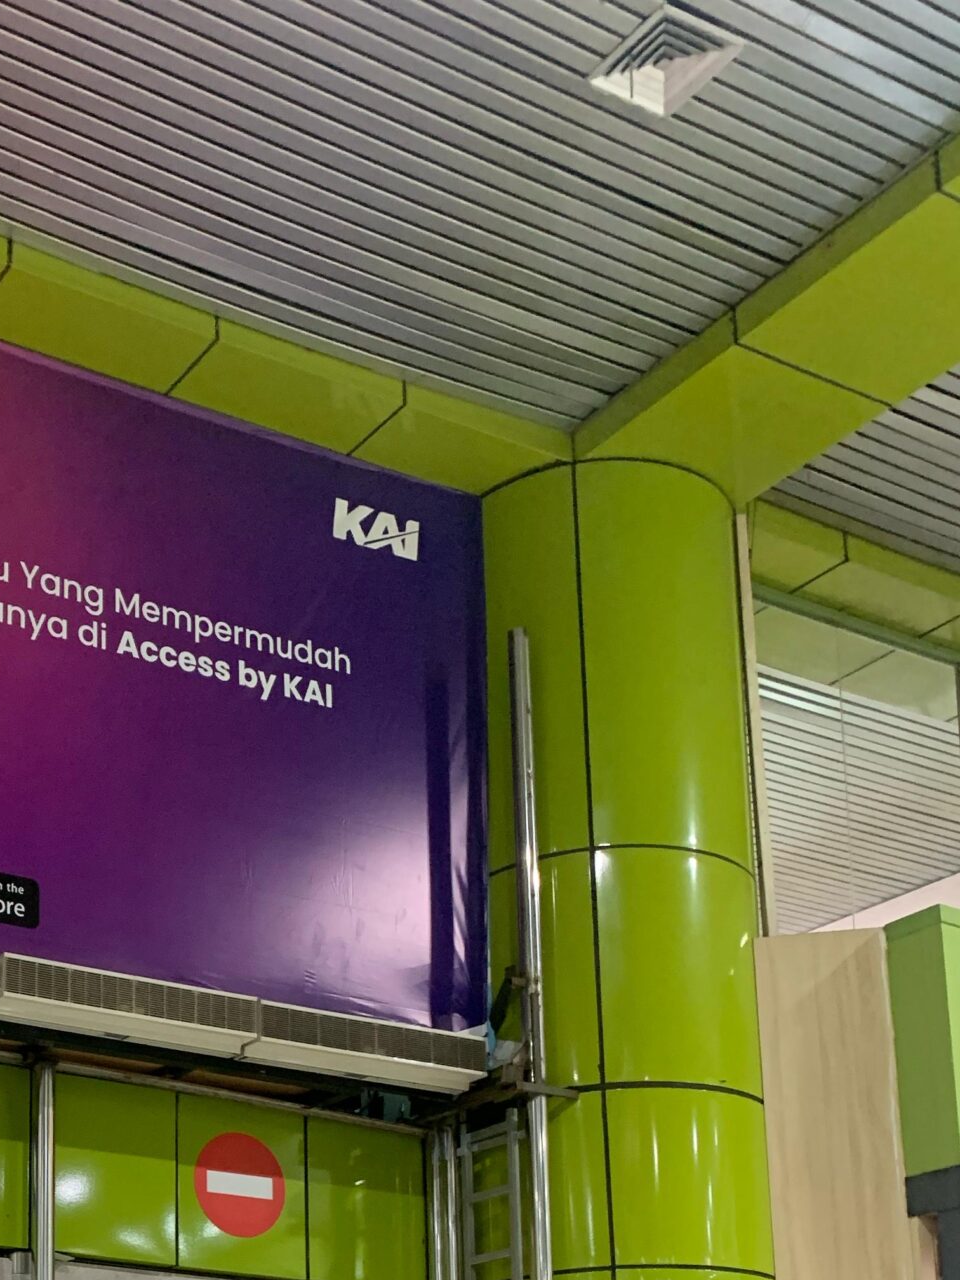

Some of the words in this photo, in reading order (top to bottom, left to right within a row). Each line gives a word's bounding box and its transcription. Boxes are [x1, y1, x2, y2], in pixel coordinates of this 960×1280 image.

[332, 496, 420, 562] KAI
[19, 560, 104, 616] Yang
[114, 587, 352, 675] Mempermudah
[77, 620, 108, 651] di
[116, 630, 231, 682] Access
[238, 658, 277, 701] by
[283, 672, 334, 709] KAI
[5, 880, 25, 896] the
